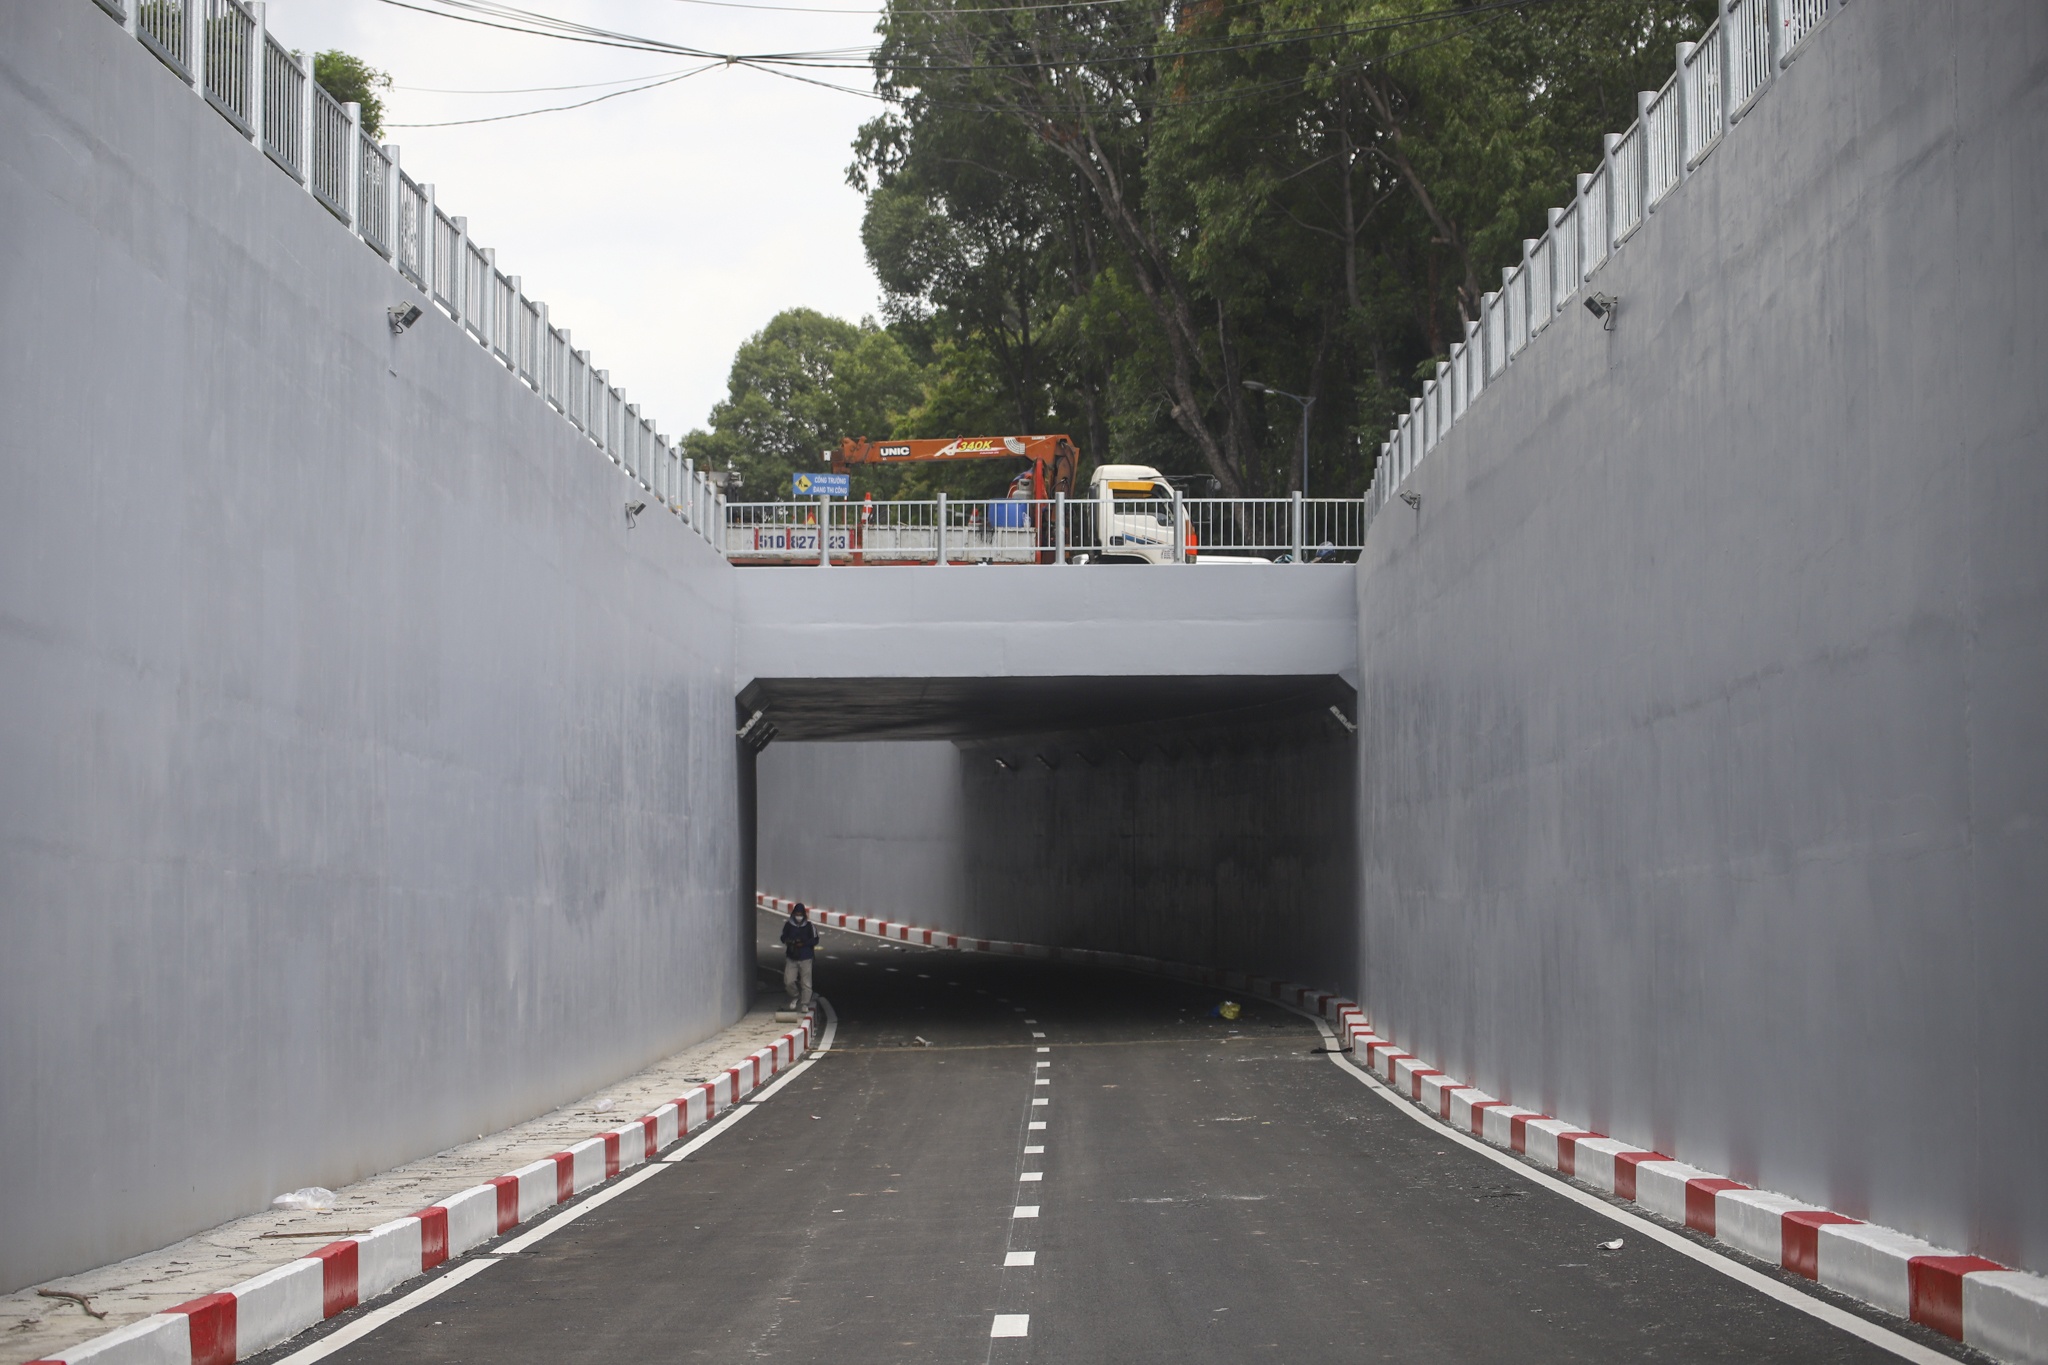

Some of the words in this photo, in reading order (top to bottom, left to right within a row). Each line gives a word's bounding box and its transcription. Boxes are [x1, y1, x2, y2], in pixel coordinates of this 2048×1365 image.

[960, 440, 993, 451] 340K
[880, 446, 909, 456] UNIC
[835, 486, 847, 494] CÔNG
[791, 536, 816, 549] 827
